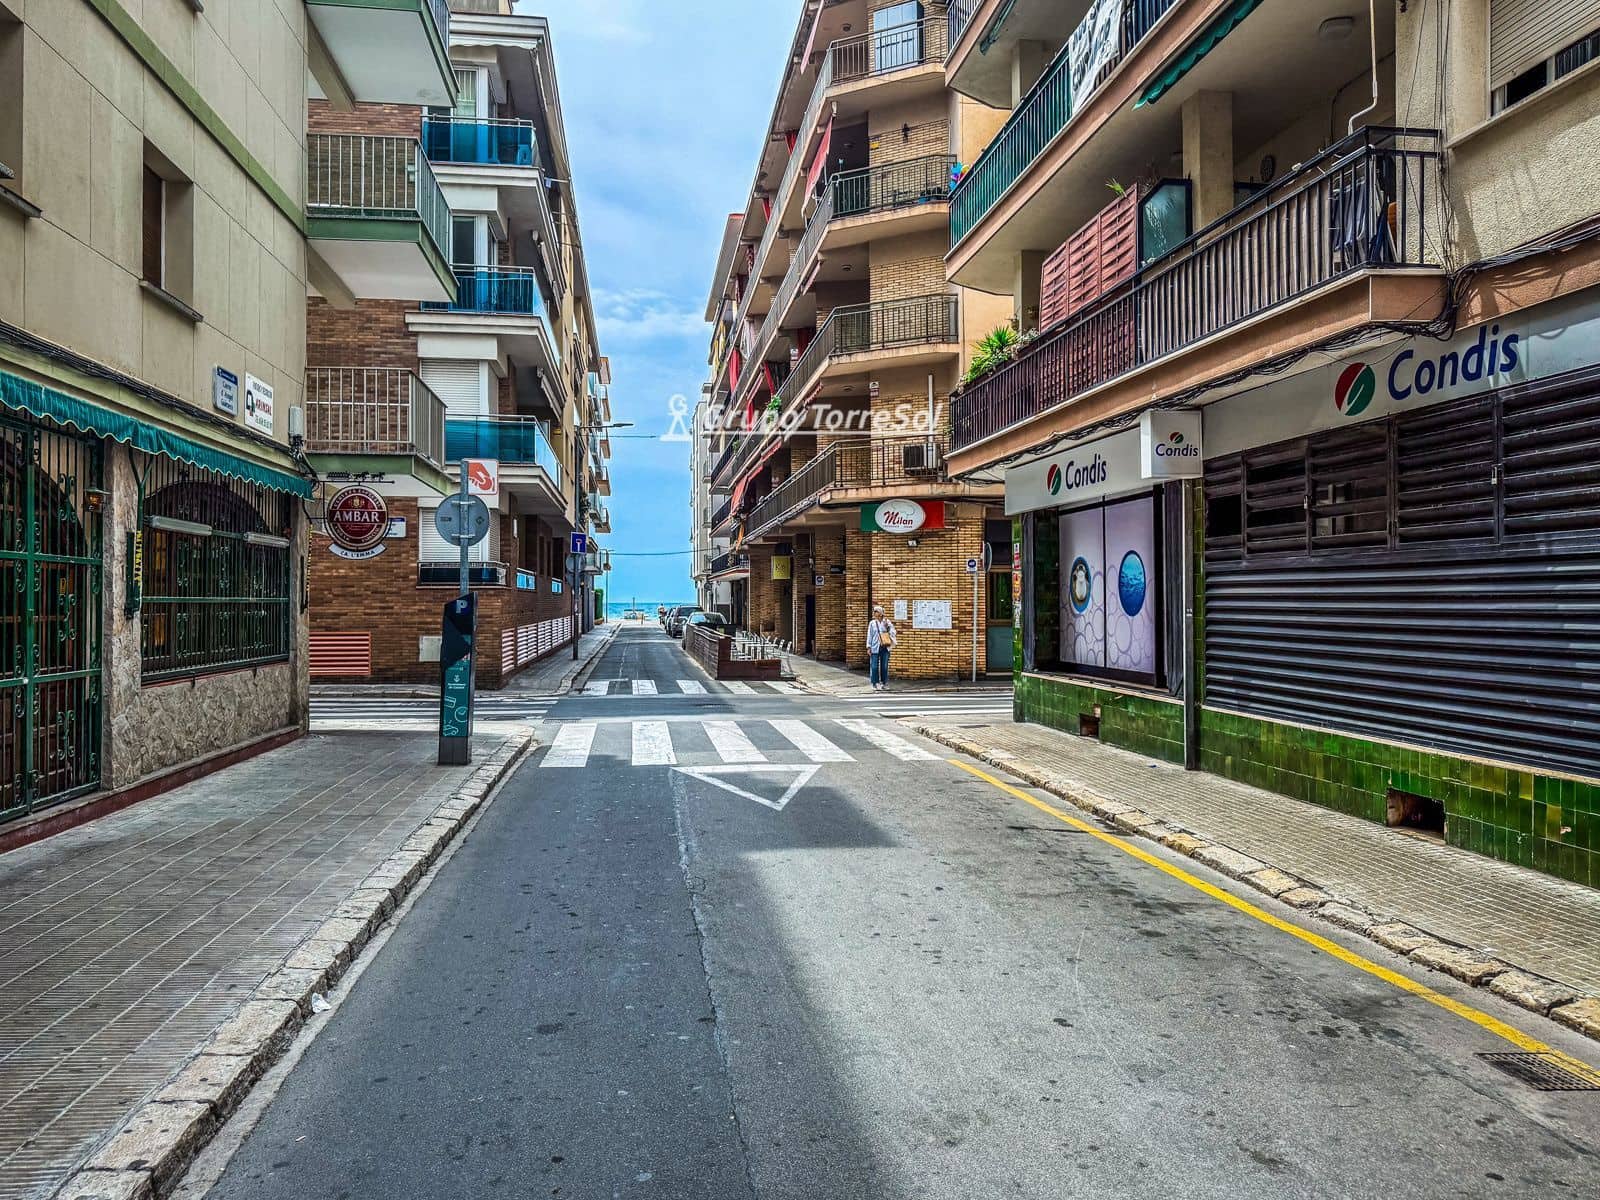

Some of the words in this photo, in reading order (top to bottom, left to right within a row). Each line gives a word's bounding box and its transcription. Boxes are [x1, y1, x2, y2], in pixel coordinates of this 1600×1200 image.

[1388, 325, 1519, 400] Condis
[1155, 443, 1199, 457] Condis
[1065, 453, 1107, 490] Condis
[333, 511, 380, 523] AMBAR
[883, 511, 914, 526] Milan
